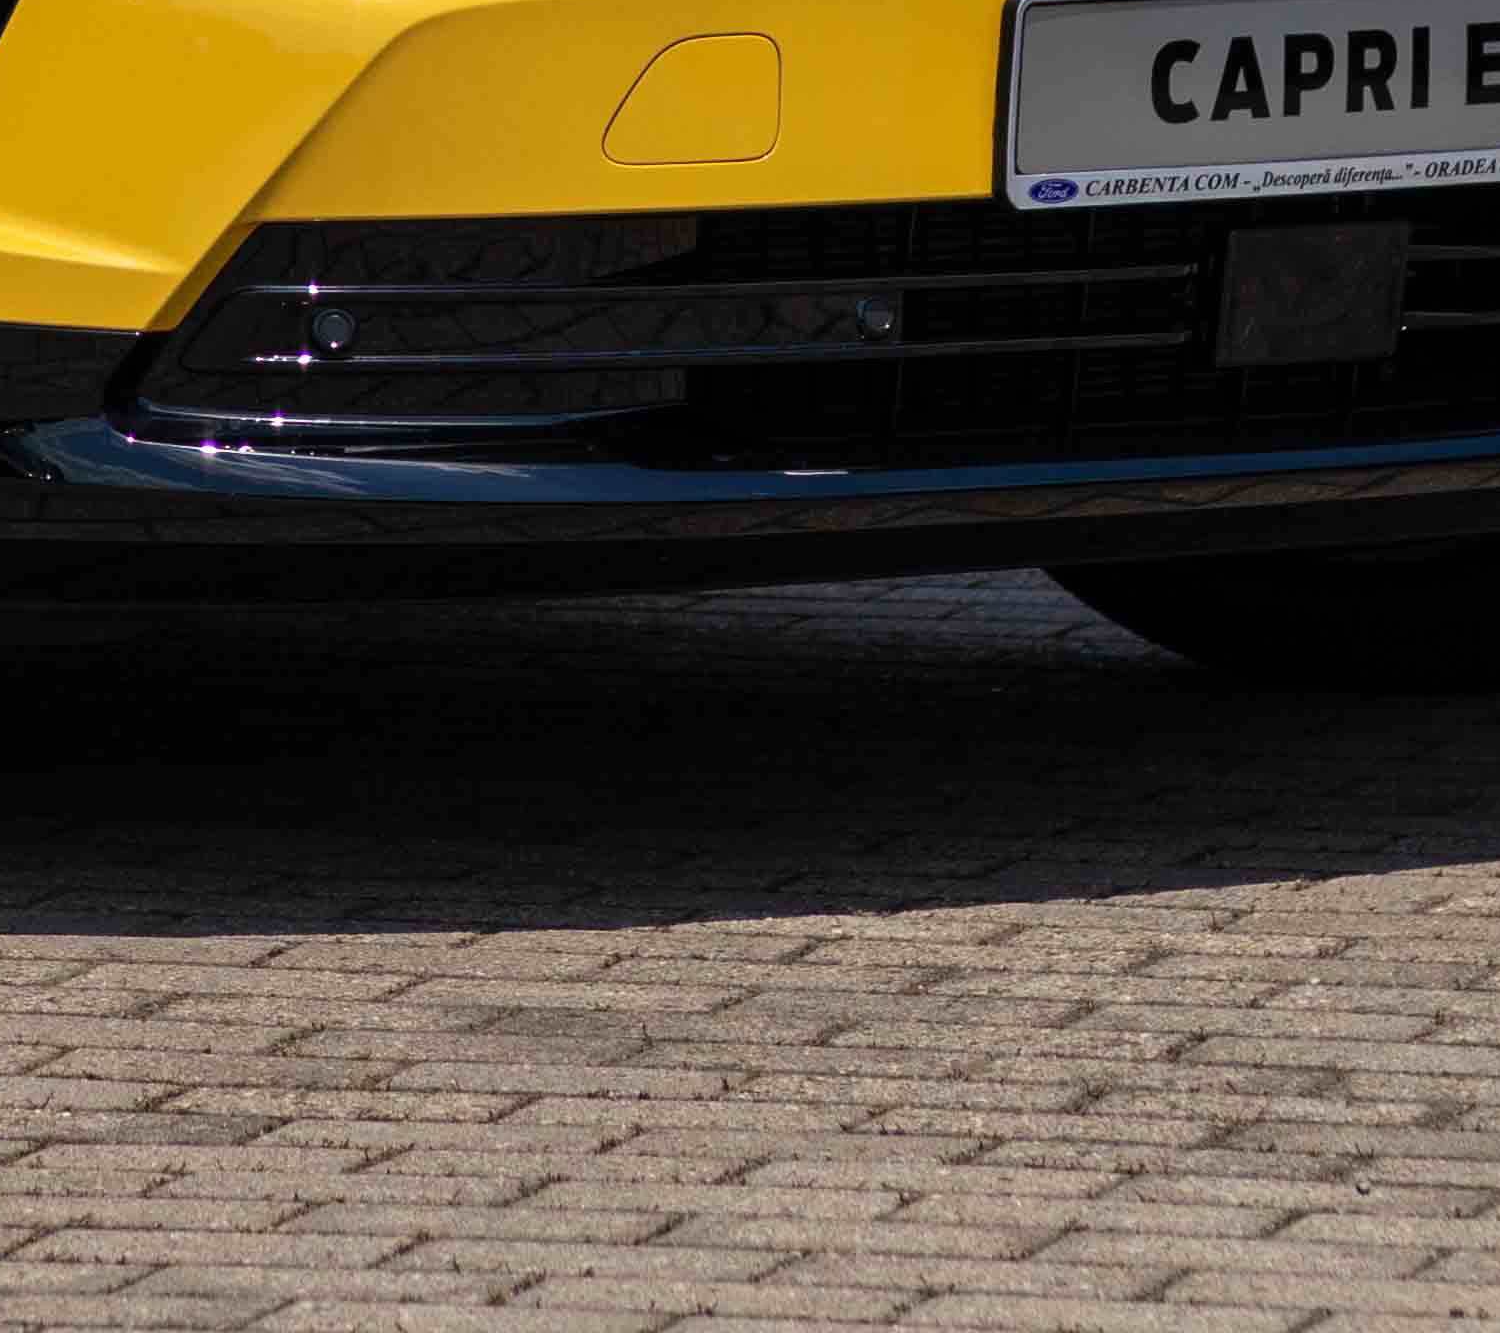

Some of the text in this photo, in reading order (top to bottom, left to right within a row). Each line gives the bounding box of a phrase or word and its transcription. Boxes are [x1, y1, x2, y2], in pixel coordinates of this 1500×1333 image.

[1150, 24, 1430, 125] CAPRI
[1085, 176, 1190, 197] CARBENTA
[1193, 171, 1241, 192] COM
[1424, 157, 1497, 179] ORADEA
